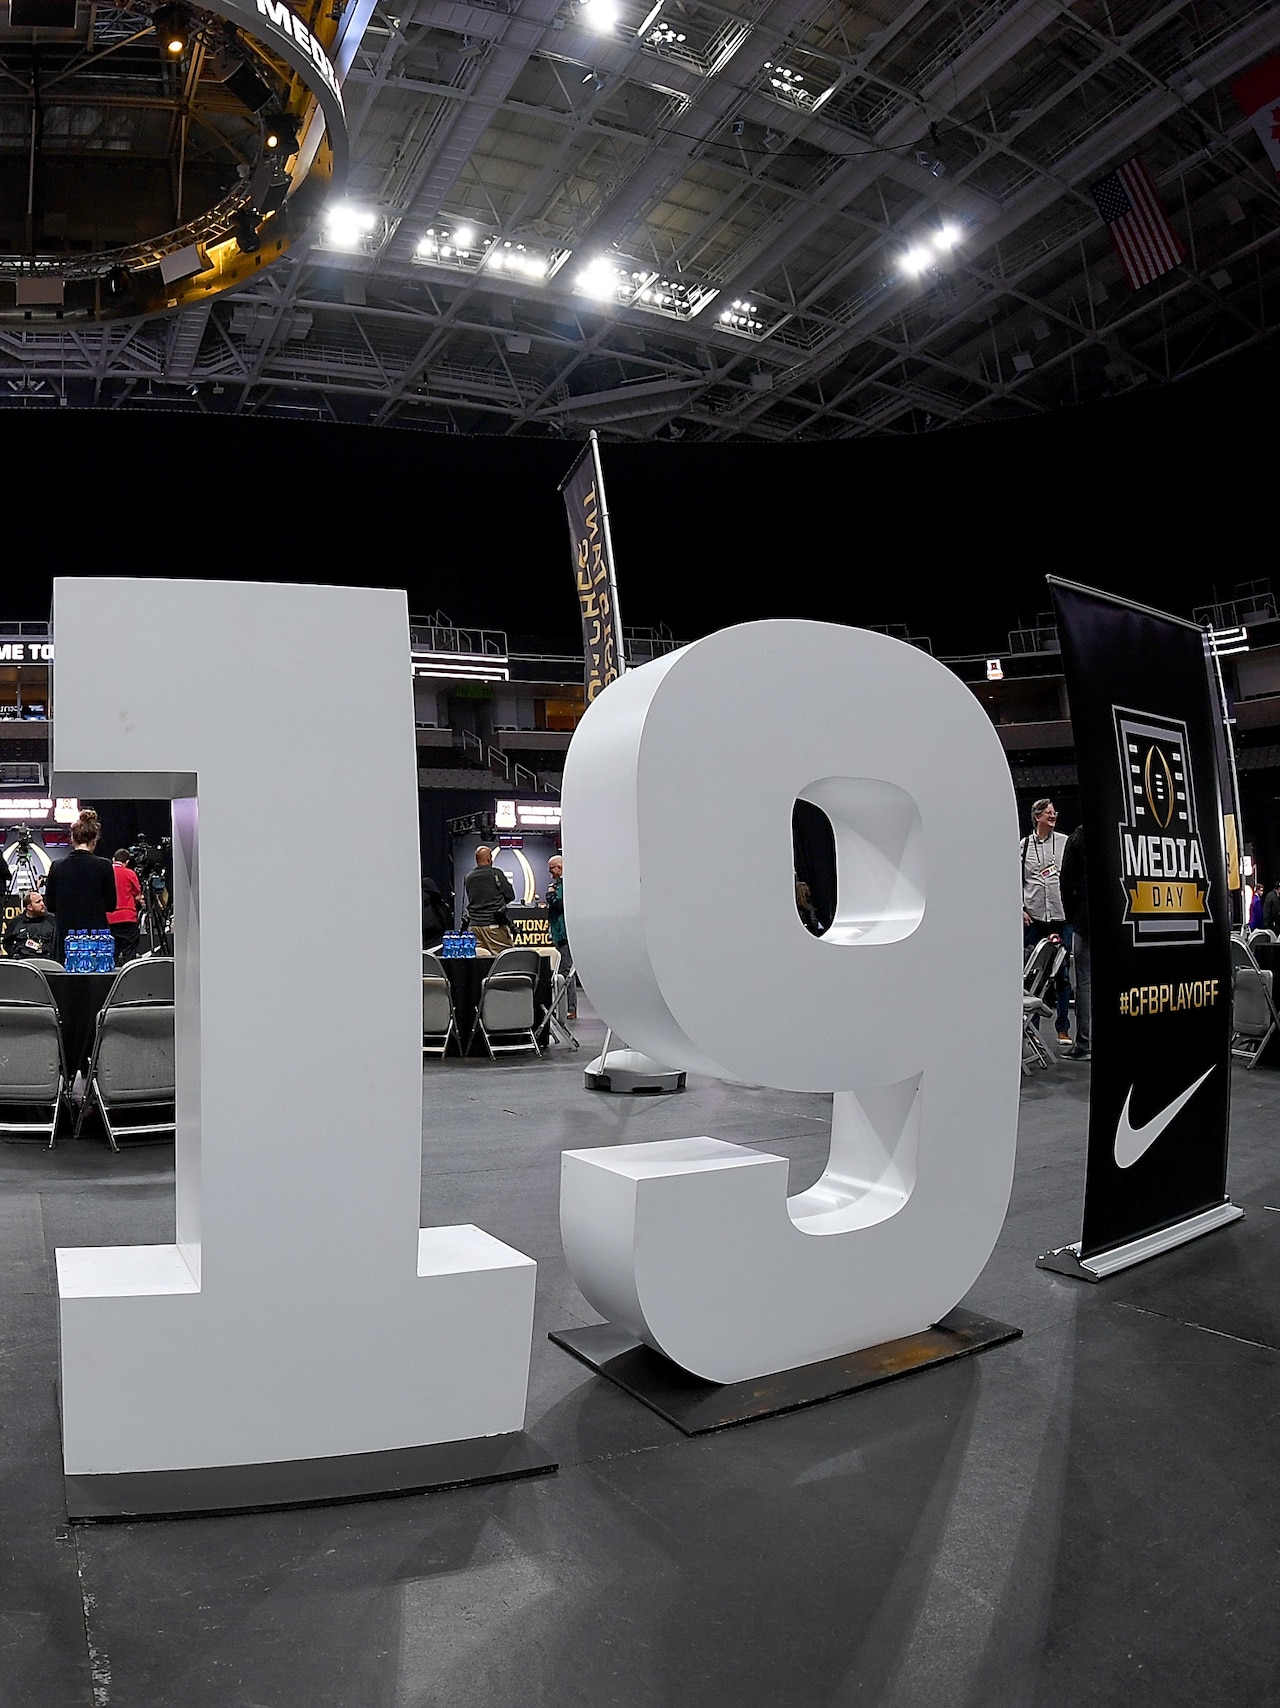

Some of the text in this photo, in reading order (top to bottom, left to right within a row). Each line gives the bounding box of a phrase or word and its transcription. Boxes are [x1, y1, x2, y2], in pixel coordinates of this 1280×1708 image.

[28, 644, 55, 660] TO
[1124, 833, 1204, 879] MEDIA
[1152, 886, 1184, 907] DAY
[1120, 979, 1219, 1017] #CFBPLAYOFF
